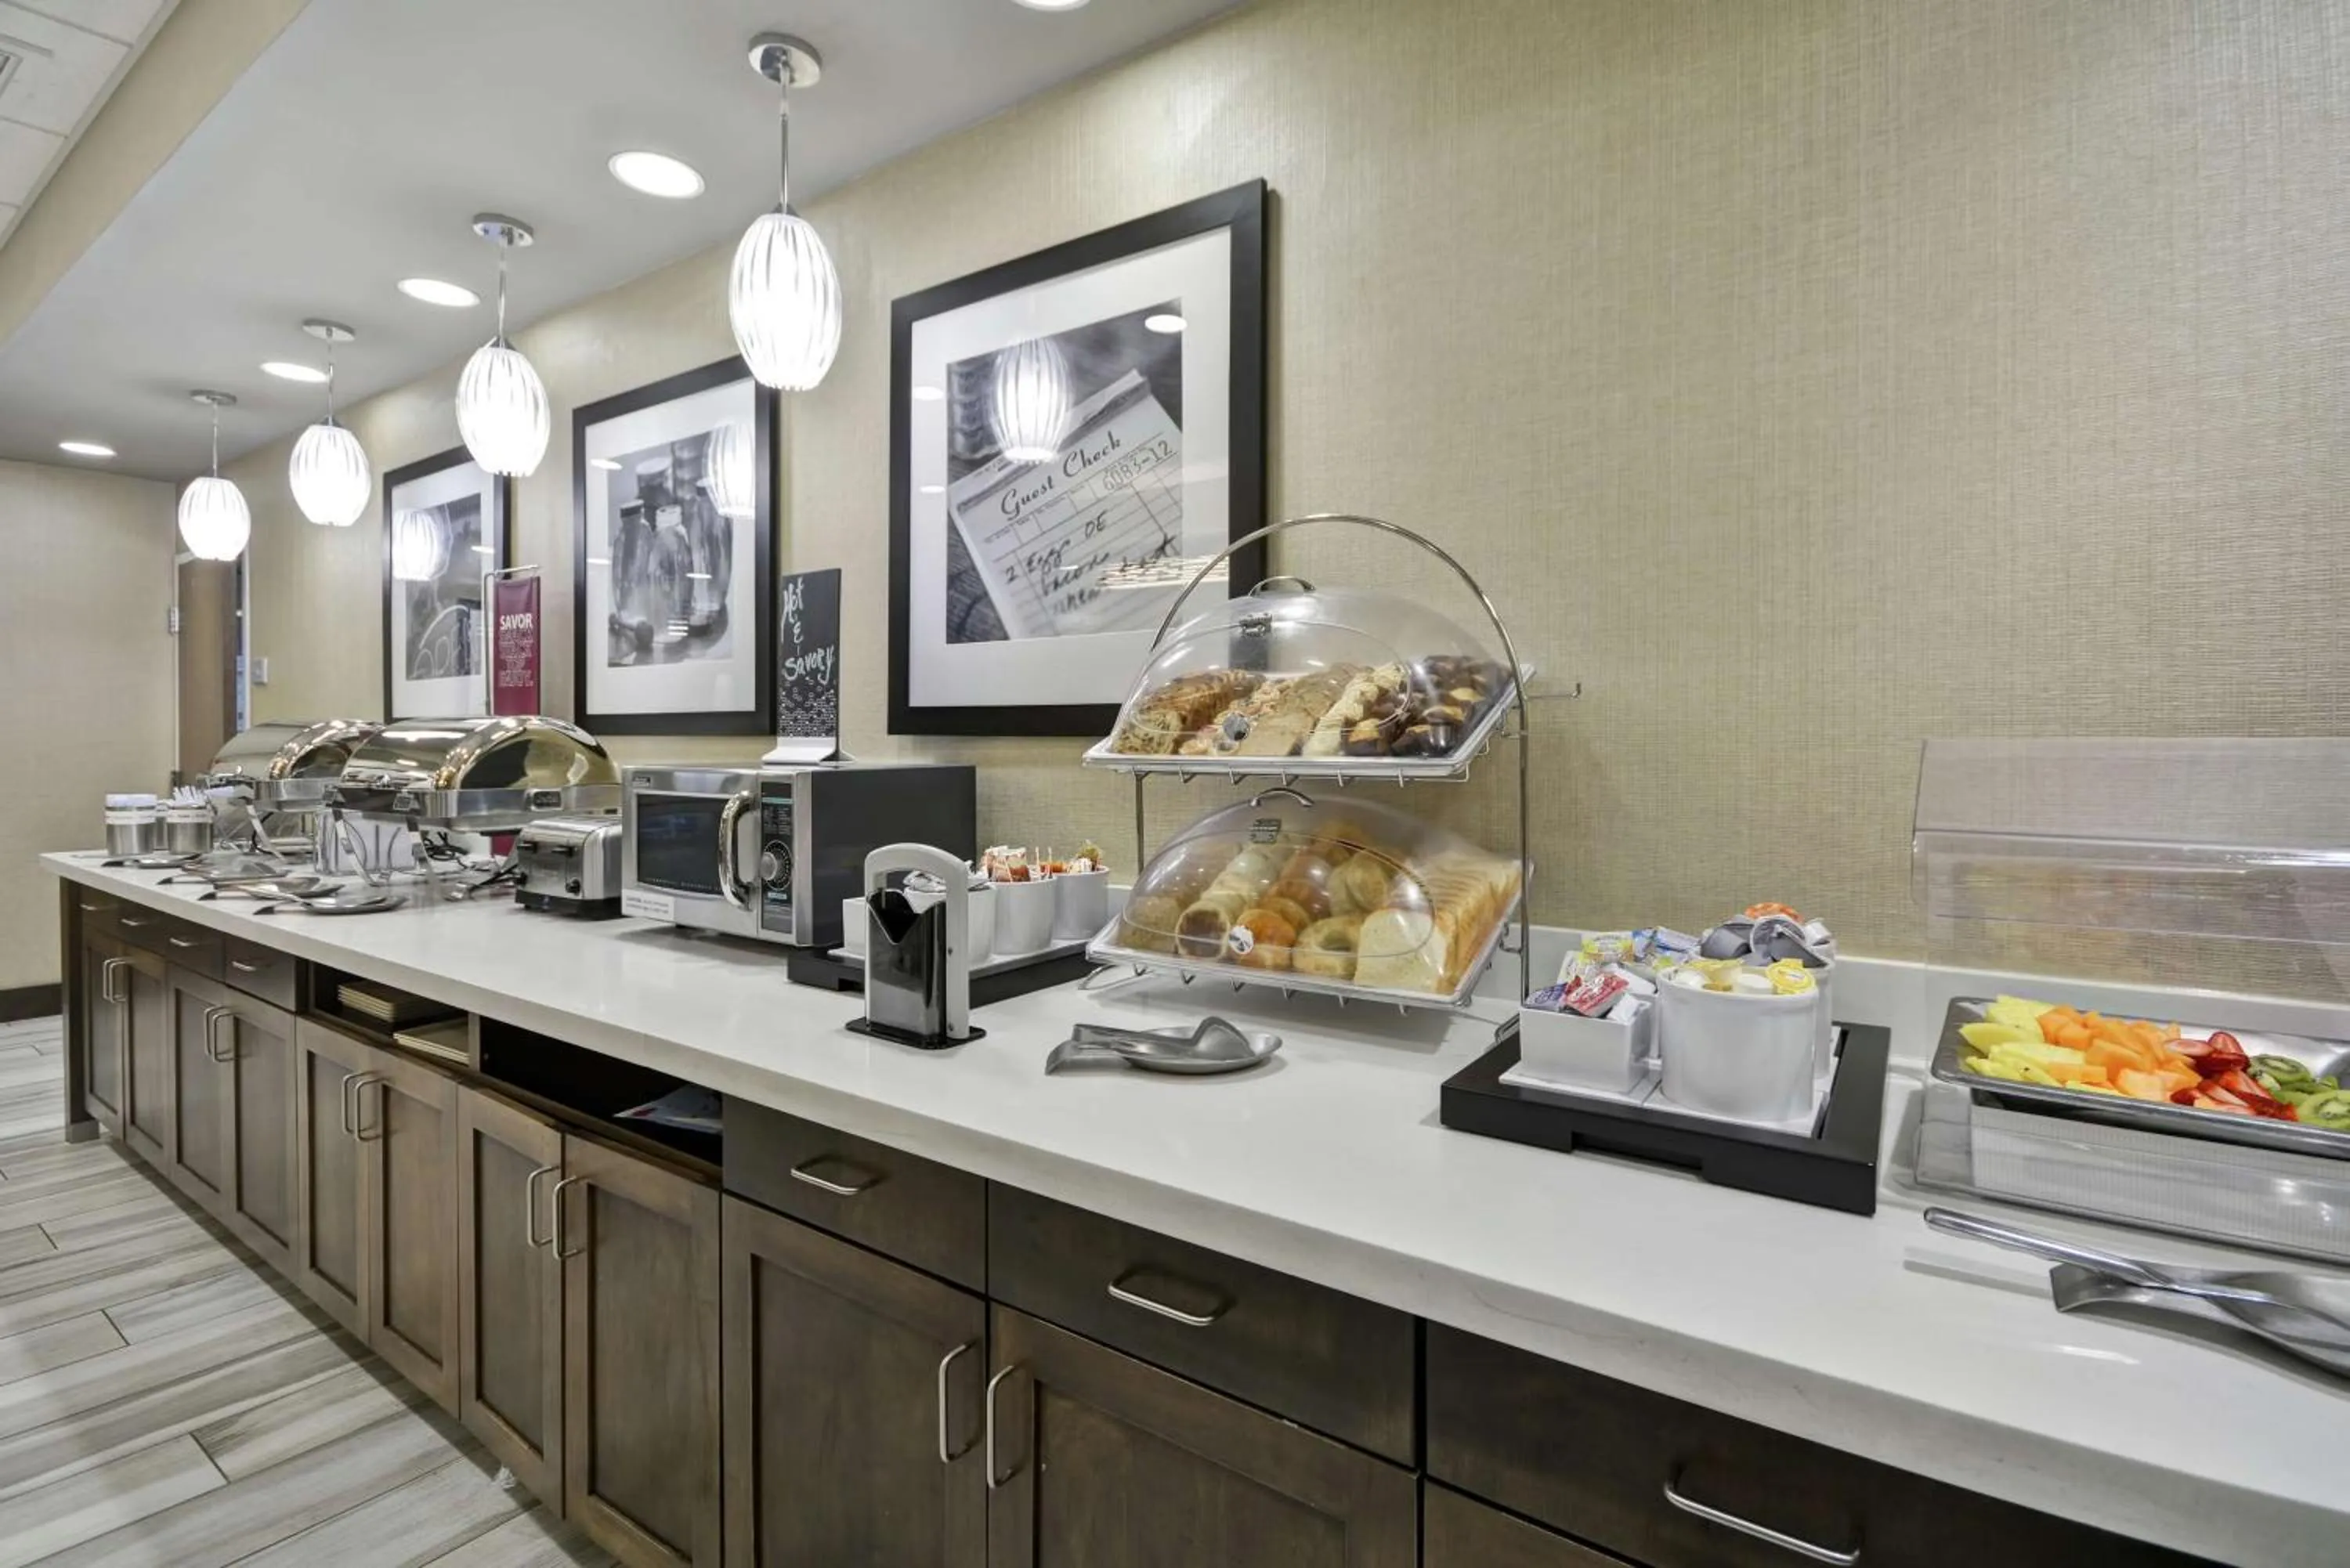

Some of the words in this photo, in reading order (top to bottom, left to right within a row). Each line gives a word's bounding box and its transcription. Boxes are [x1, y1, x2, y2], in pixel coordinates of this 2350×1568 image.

[1000, 475, 1055, 522] Guest
[1062, 430, 1121, 478] Check
[499, 612, 533, 630] SAVOR
